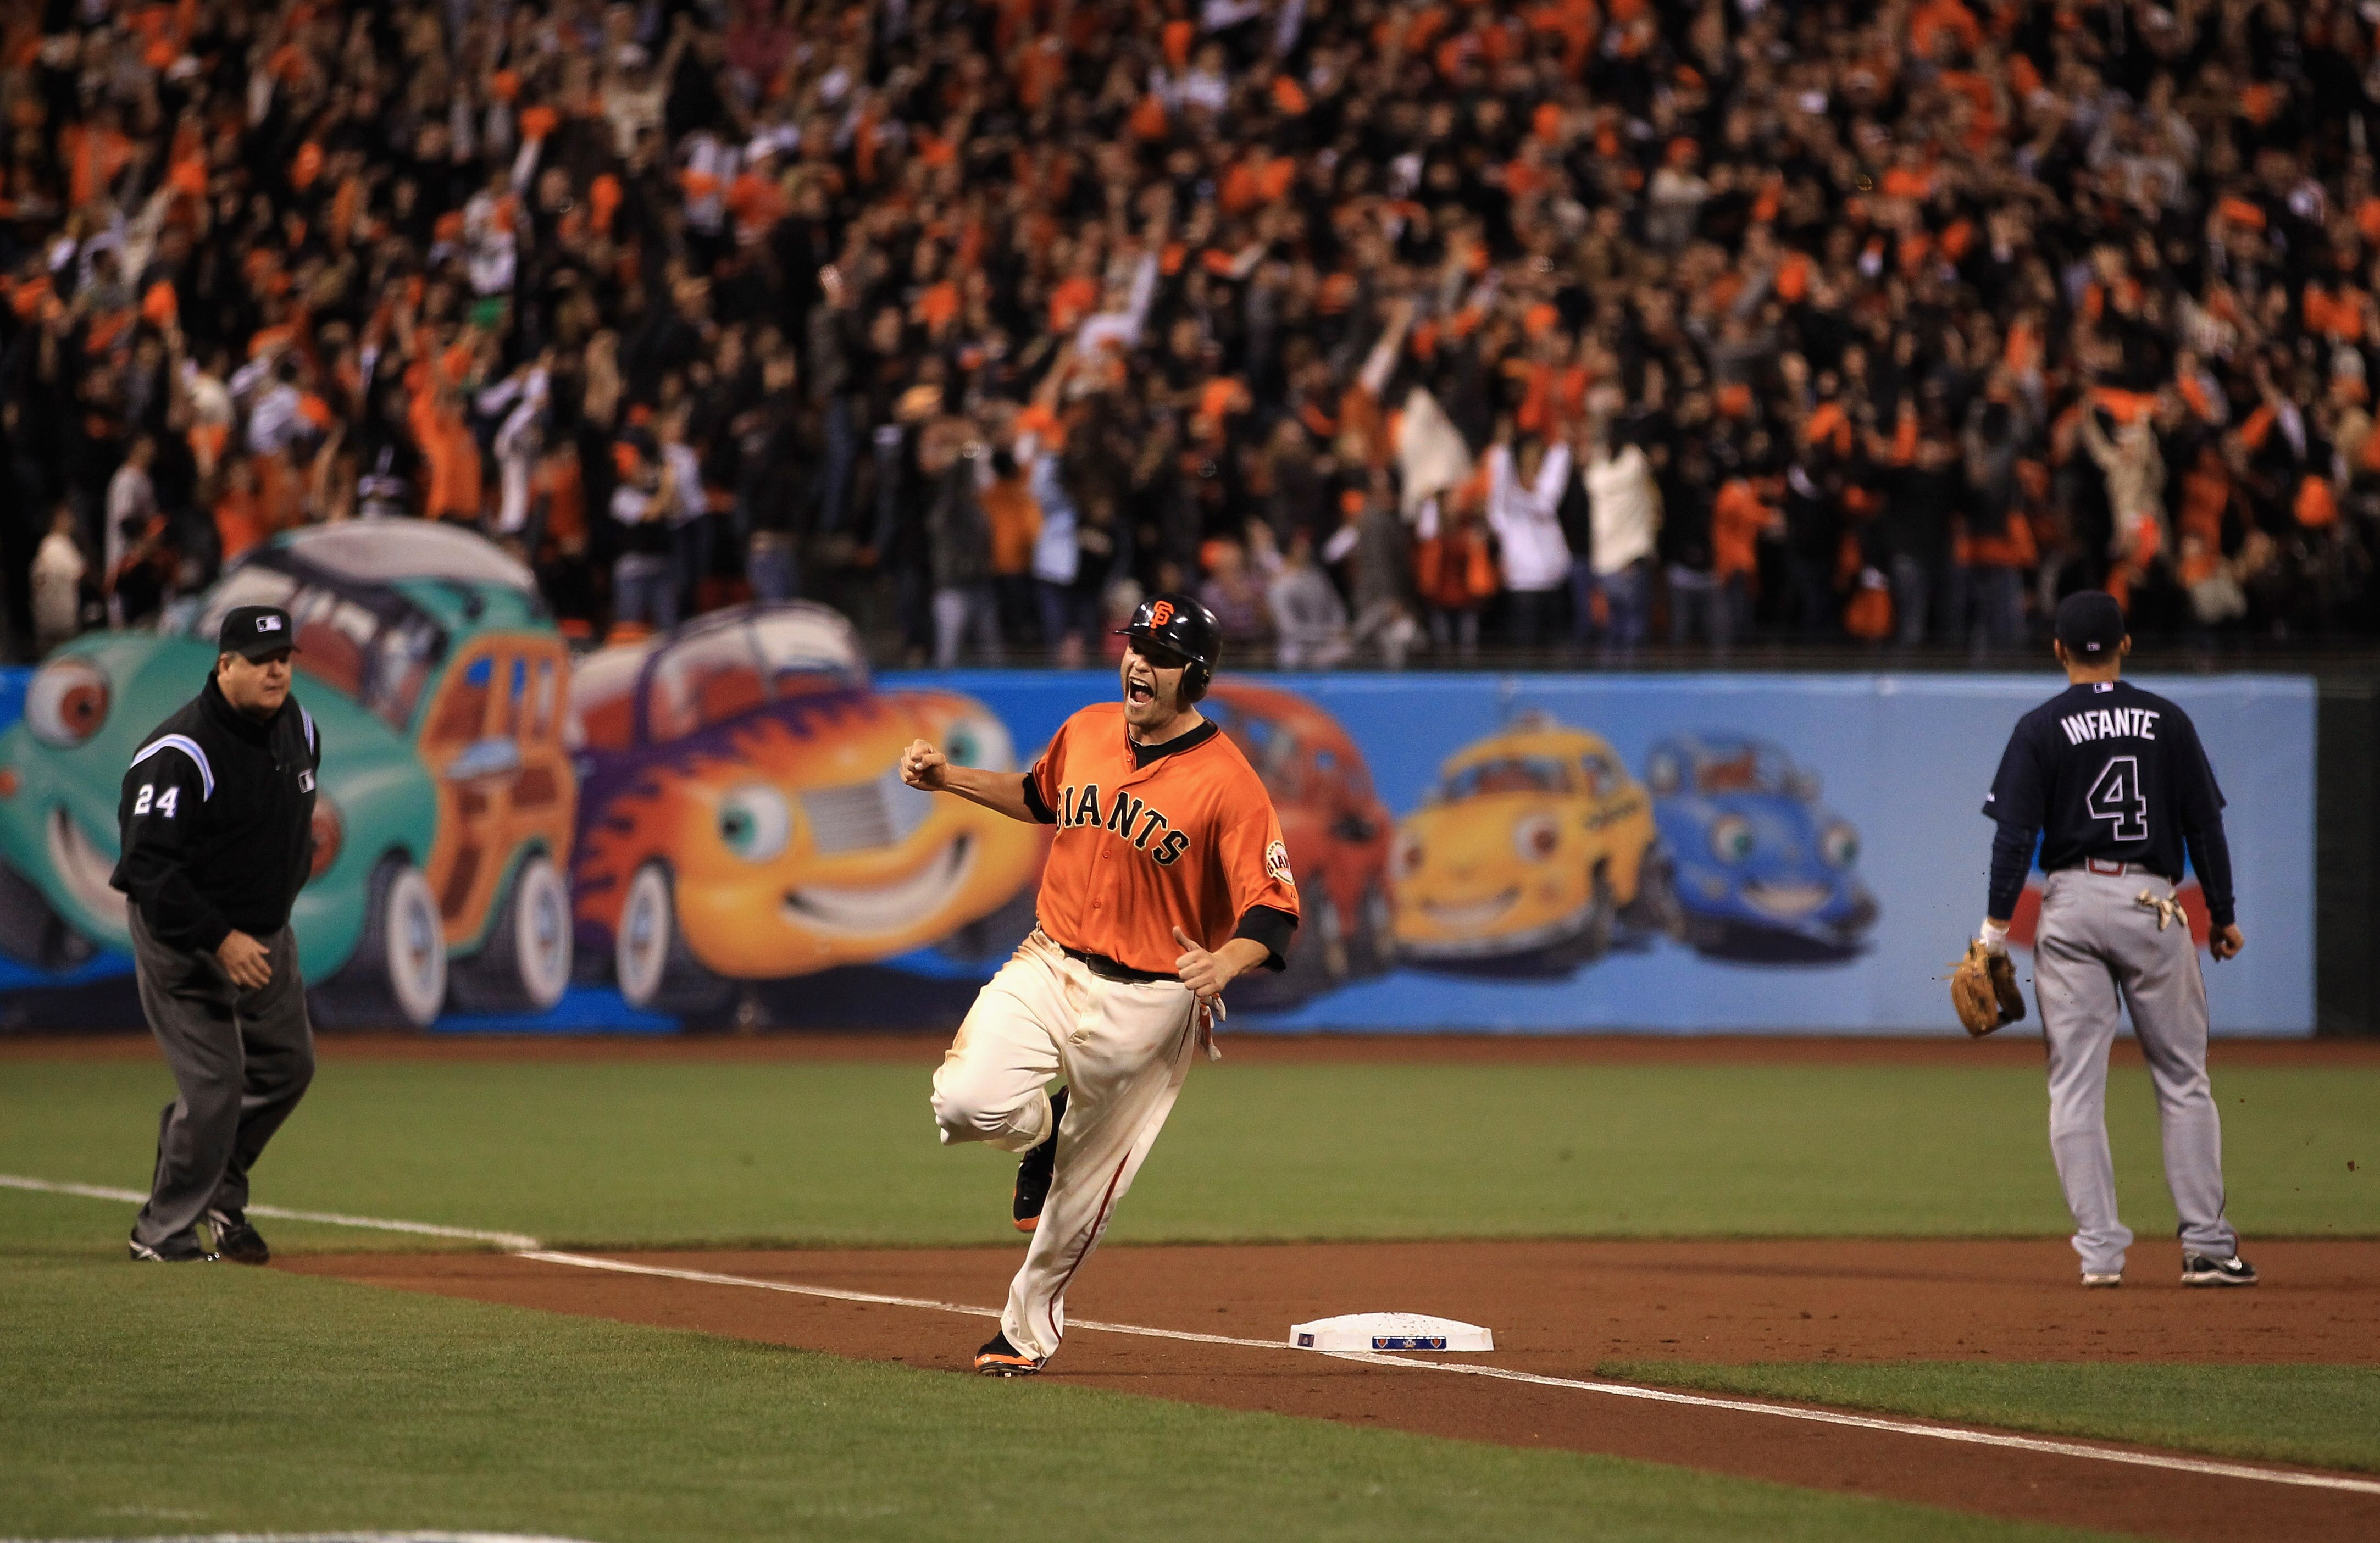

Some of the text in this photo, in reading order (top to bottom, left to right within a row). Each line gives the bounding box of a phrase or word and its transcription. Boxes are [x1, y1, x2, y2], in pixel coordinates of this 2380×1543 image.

[1150, 600, 1174, 629] SF
[2060, 707, 2160, 746] INFANTE
[134, 783, 181, 819] 24
[2085, 755, 2148, 841] 4
